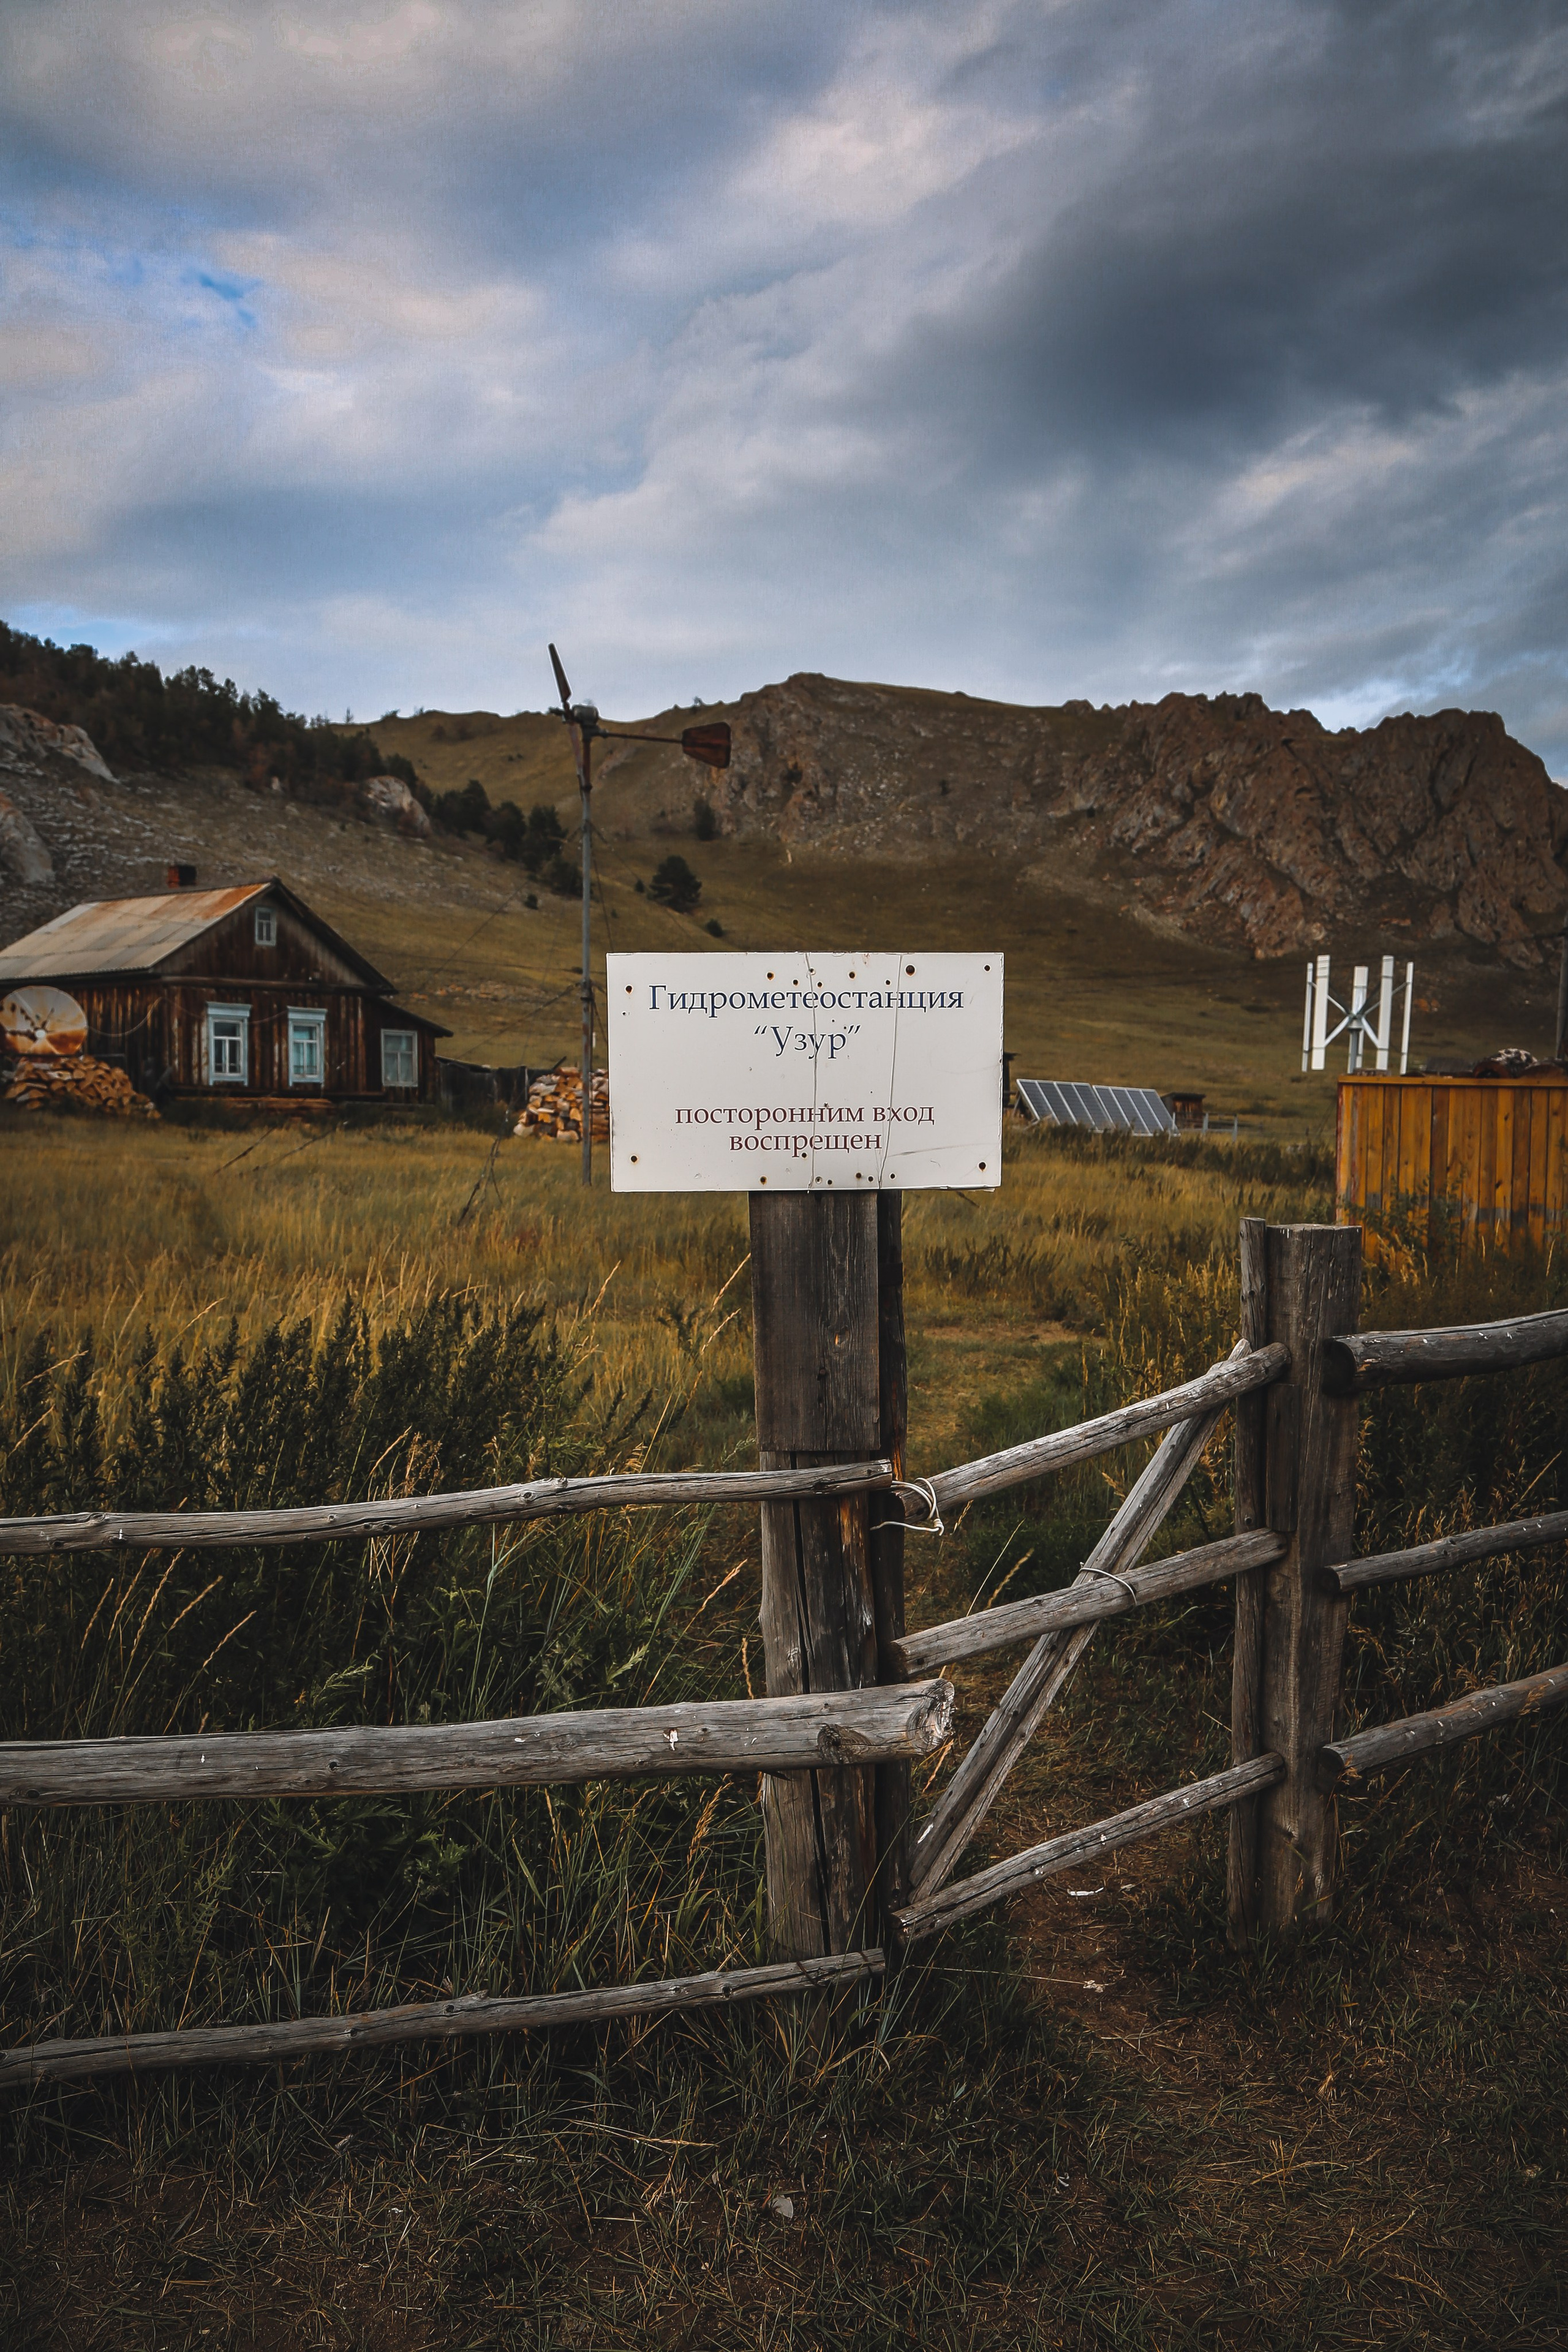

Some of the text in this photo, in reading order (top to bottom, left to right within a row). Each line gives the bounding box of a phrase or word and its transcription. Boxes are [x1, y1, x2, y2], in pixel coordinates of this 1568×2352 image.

[649, 984, 964, 1018] Гидрометеостанция
[675, 1105, 935, 1131] посторонним вход
[729, 1133, 883, 1157] воспрещен
